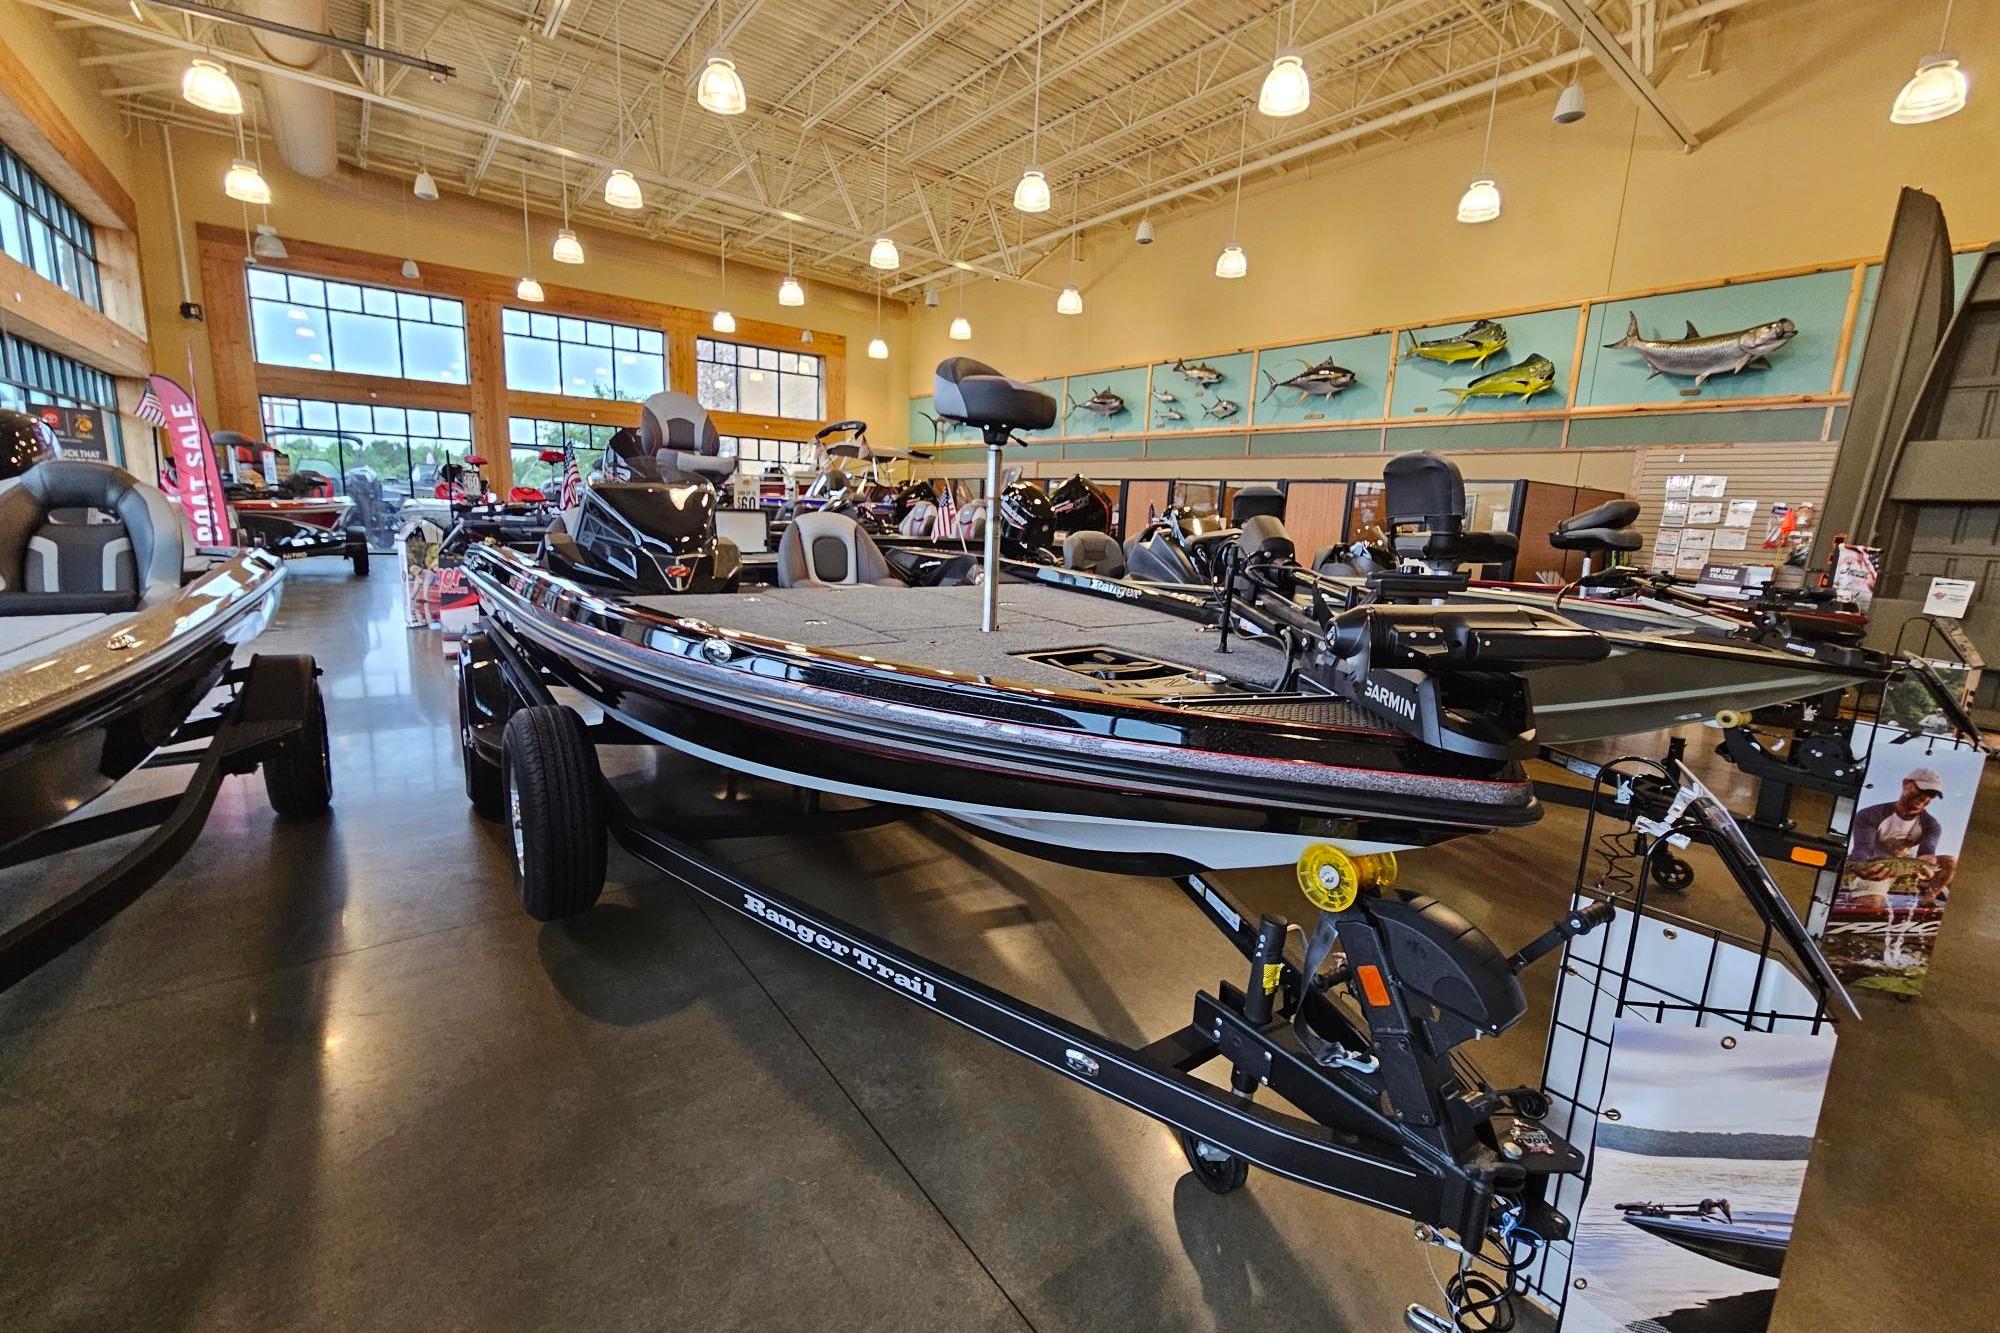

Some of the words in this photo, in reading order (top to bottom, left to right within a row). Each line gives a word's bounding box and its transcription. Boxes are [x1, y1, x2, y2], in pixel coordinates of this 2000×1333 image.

[80, 449, 100, 458] THAT
[170, 402, 204, 468] SALE
[189, 476, 224, 542] BOAT
[1091, 578, 1142, 599] Ranger
[743, 893, 850, 957] Ranger
[852, 947, 937, 1002] Trail
